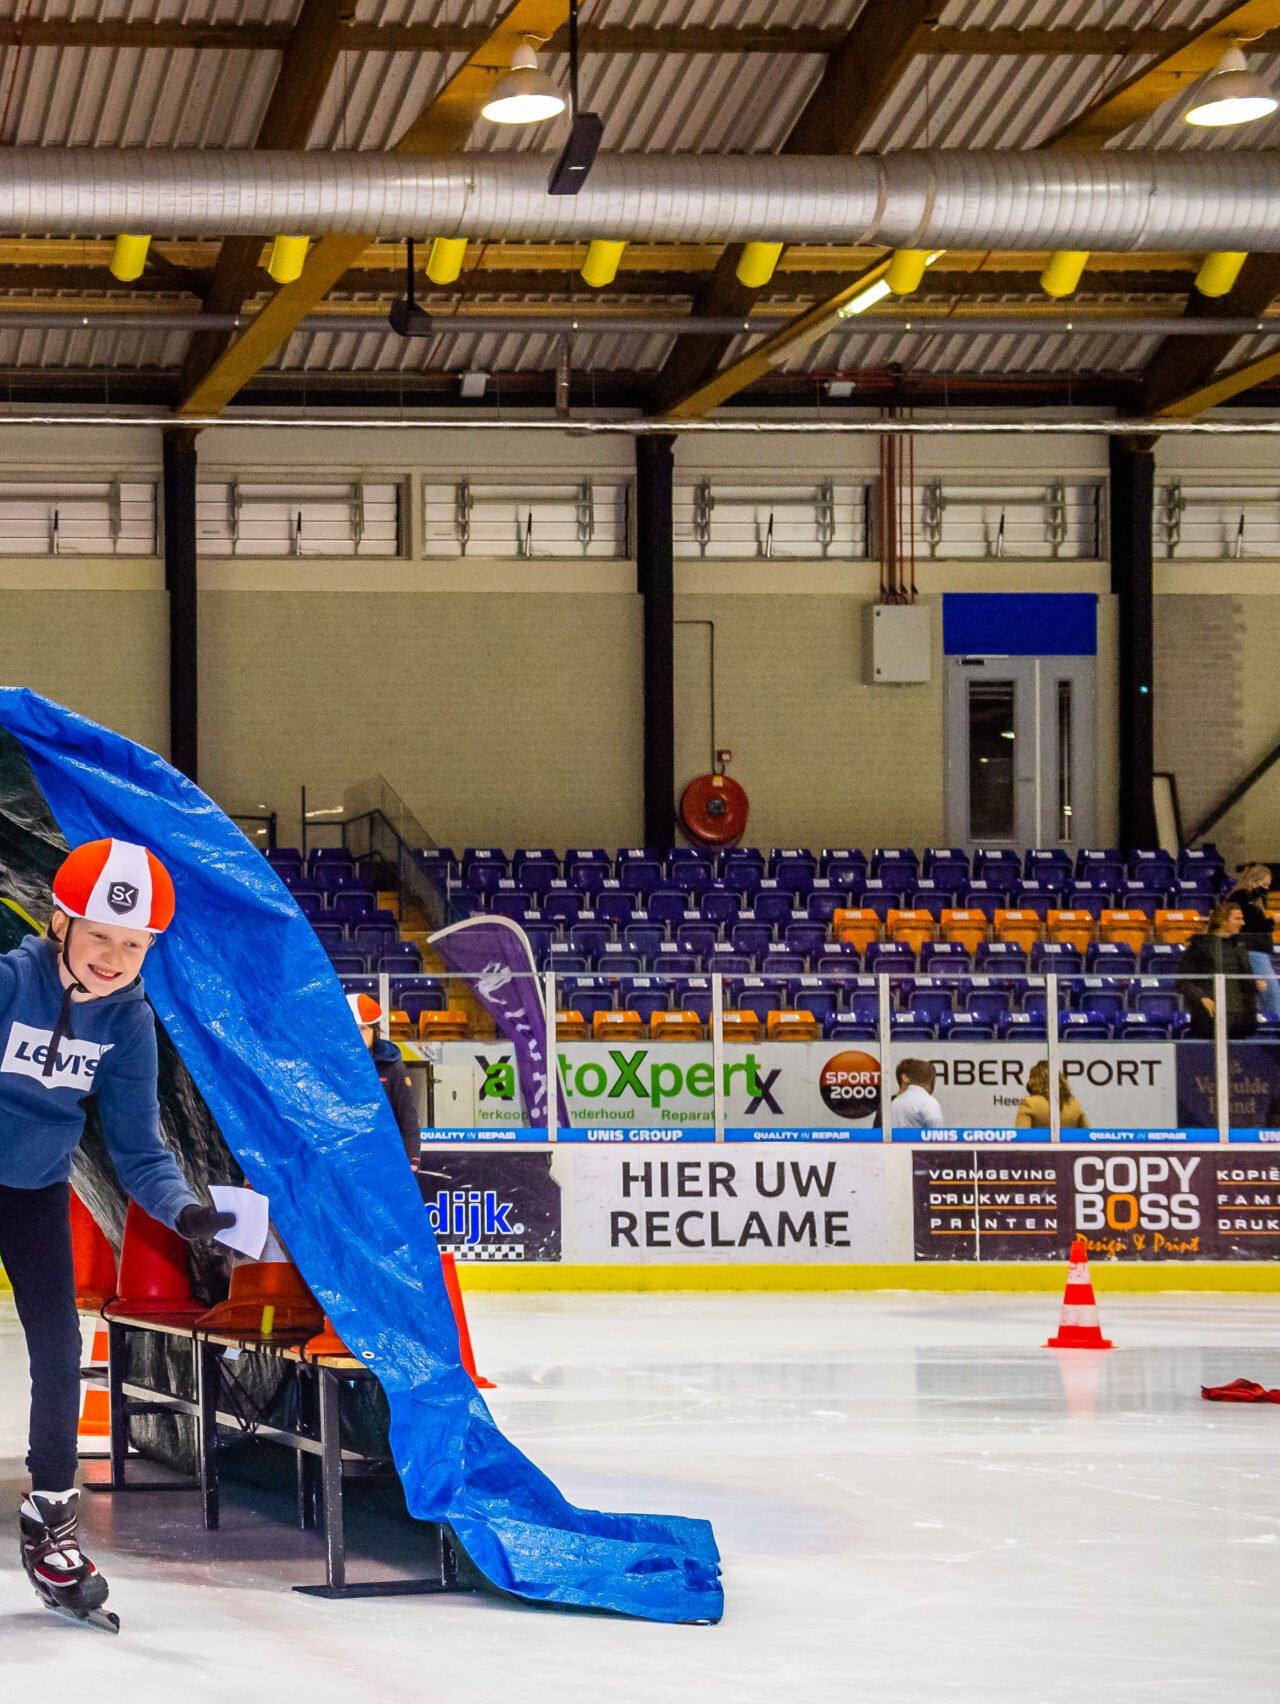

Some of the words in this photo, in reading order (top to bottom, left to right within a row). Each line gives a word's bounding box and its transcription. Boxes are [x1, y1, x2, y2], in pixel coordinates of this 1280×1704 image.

[826, 1071, 881, 1084] SPORT
[931, 1060, 1024, 1086] ABER
[1062, 1060, 1162, 1086] PORT
[485, 1051, 762, 1108] atoXpert
[830, 1087, 877, 1099] 2000
[571, 1109, 635, 1120] nderhoud
[420, 1132, 465, 1140] QUALITY
[467, 1132, 476, 1140] IN
[478, 1132, 516, 1140] REPAIR
[587, 1130, 624, 1141] UNIS
[628, 1130, 683, 1141] GROUP
[753, 1131, 798, 1140] QUALITY
[812, 1132, 850, 1140] REPAIR
[921, 1130, 957, 1142] UNIS
[962, 1130, 1018, 1142] GROUP
[1089, 1131, 1135, 1141] QUALITY
[1148, 1132, 1187, 1140] REPAIR
[929, 1169, 1057, 1180] VORMGEVING
[1073, 1156, 1200, 1193] COPY
[1216, 1166, 1280, 1180] KOPIË
[622, 1161, 737, 1198] HIER
[755, 1161, 837, 1198] UW
[929, 1193, 1057, 1205] DRUKWERK
[1074, 1193, 1201, 1230] BOSS
[610, 1210, 851, 1248] RECLAME
[930, 1218, 1057, 1229] PRINTEN
[1218, 1219, 1280, 1229] DRUK
[1076, 1233, 1127, 1259] Design
[1133, 1234, 1146, 1250] &
[1153, 1232, 1199, 1252] Print
